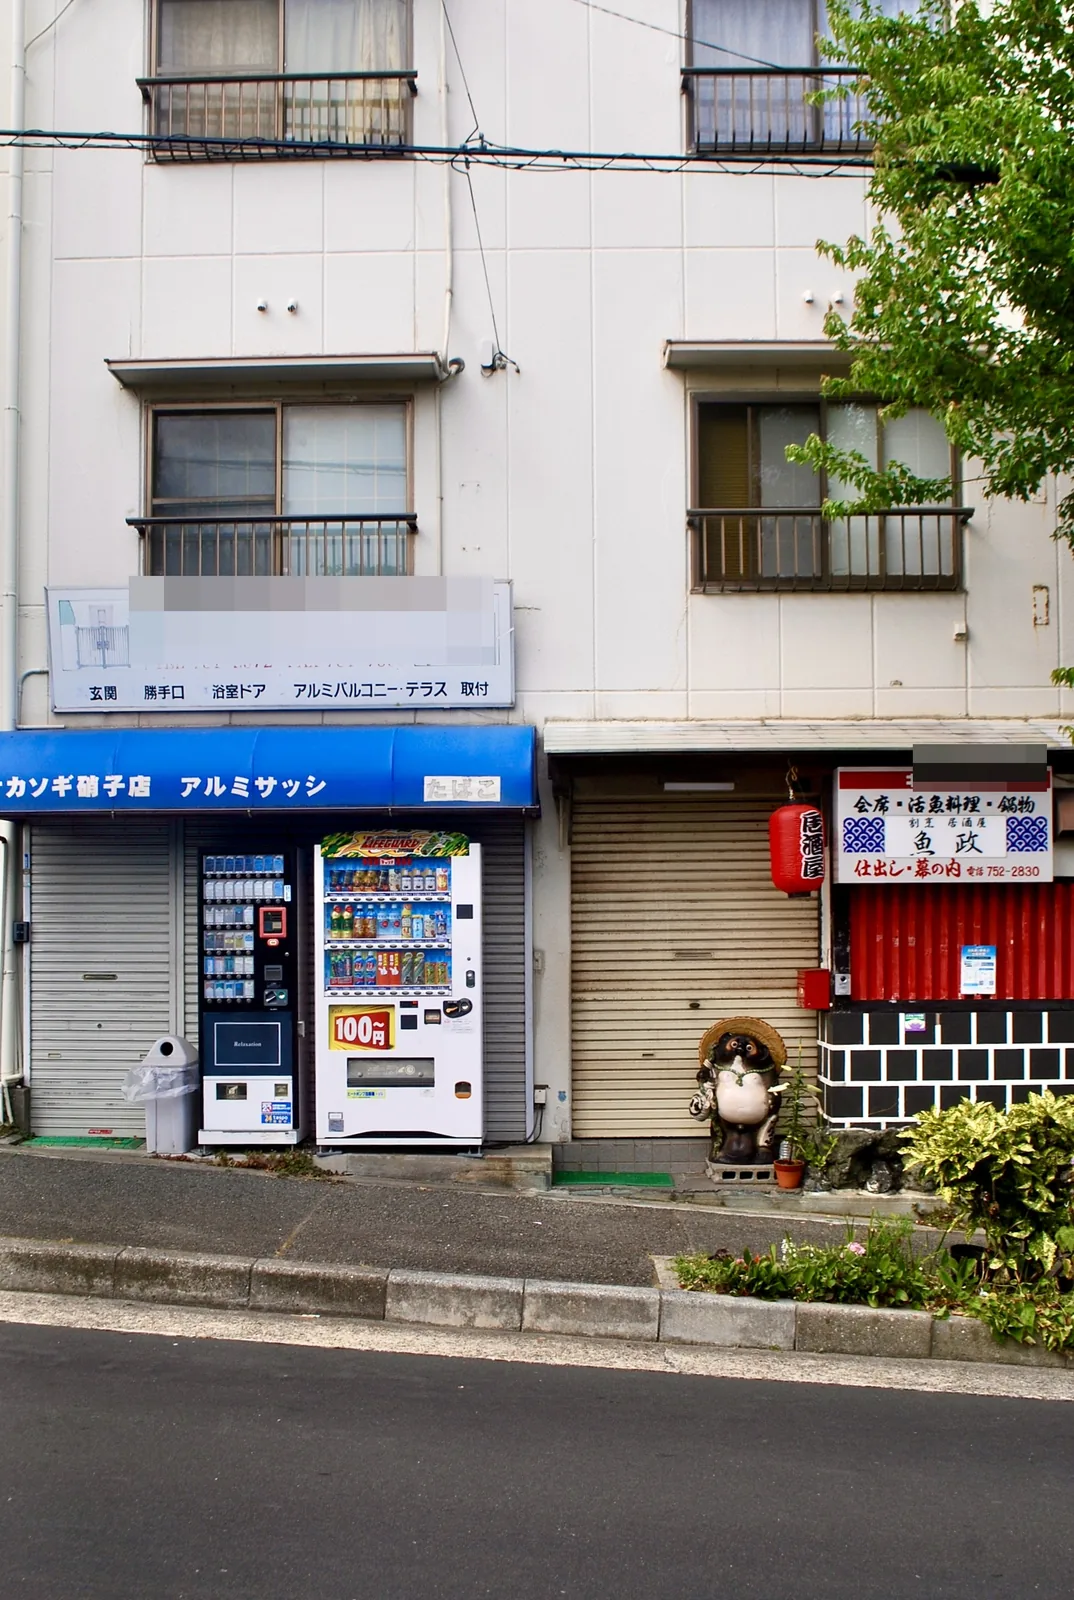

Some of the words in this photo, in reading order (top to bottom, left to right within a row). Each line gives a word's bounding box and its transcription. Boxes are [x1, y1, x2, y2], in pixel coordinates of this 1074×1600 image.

[89, 685, 118, 701] 玄関
[144, 685, 185, 700] 勝手口
[212, 684, 266, 700] 浴室ドア
[460, 681, 489, 697] 取付
[0, 774, 151, 798] カソギ硝子店
[180, 774, 327, 798] アルミサッシ
[426, 778, 497, 799] たばこ
[947, 817, 987, 829] 居酒屋
[361, 835, 420, 849] LIFEGUARD
[800, 810, 825, 879] 居酒屋
[986, 866, 1040, 877] 752-2830
